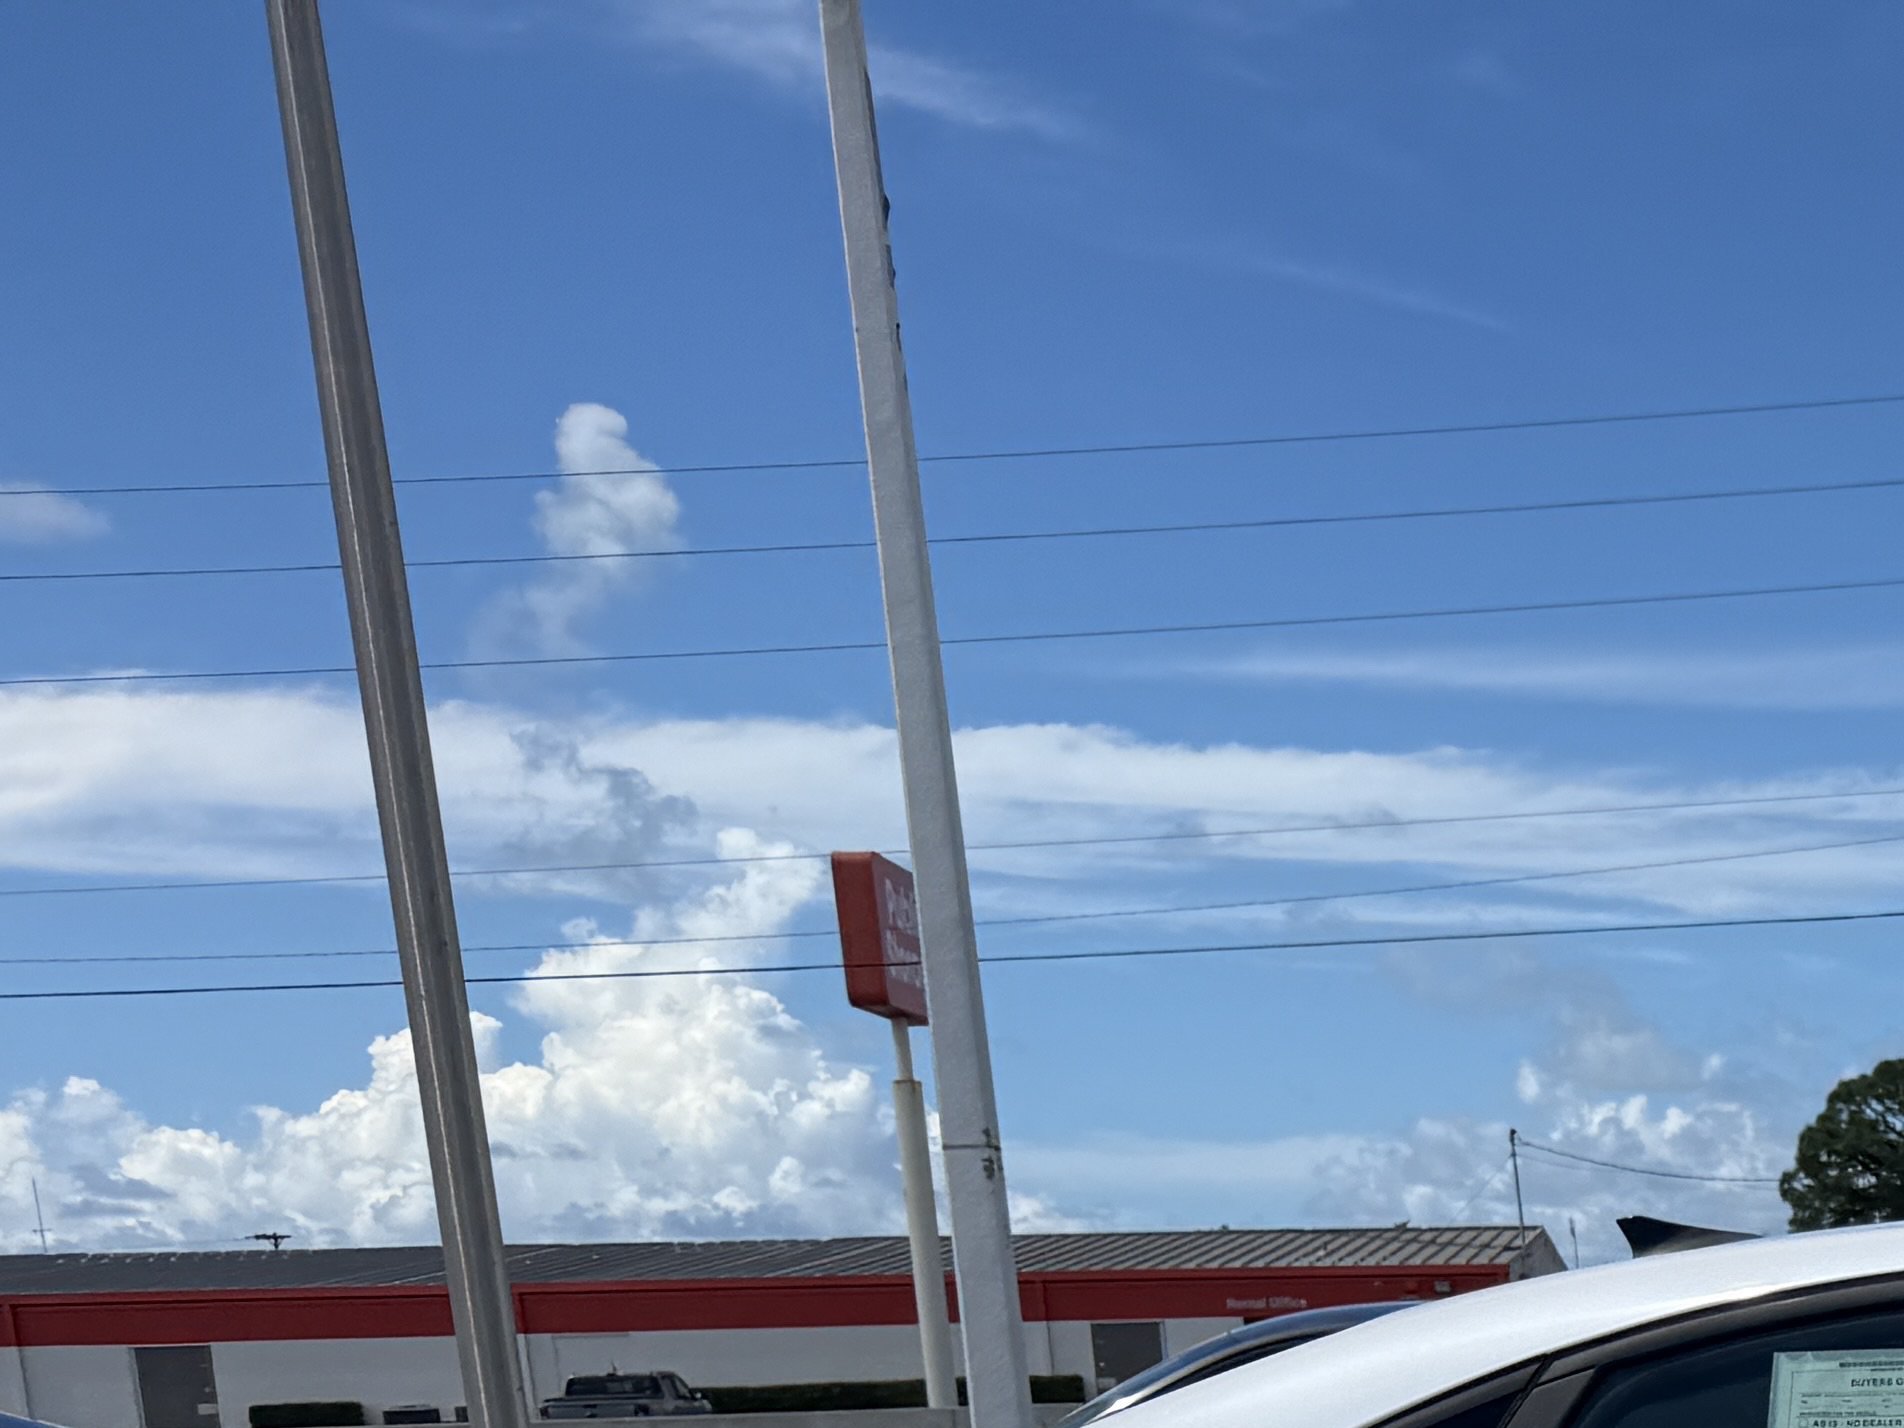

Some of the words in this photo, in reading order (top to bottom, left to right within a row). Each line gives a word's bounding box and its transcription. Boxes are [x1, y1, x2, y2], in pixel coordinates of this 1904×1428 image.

[1850, 1377, 1893, 1388] BUYERS
[1846, 1419, 1861, 1428] NO
[1862, 1418, 1903, 1427] DEALER
